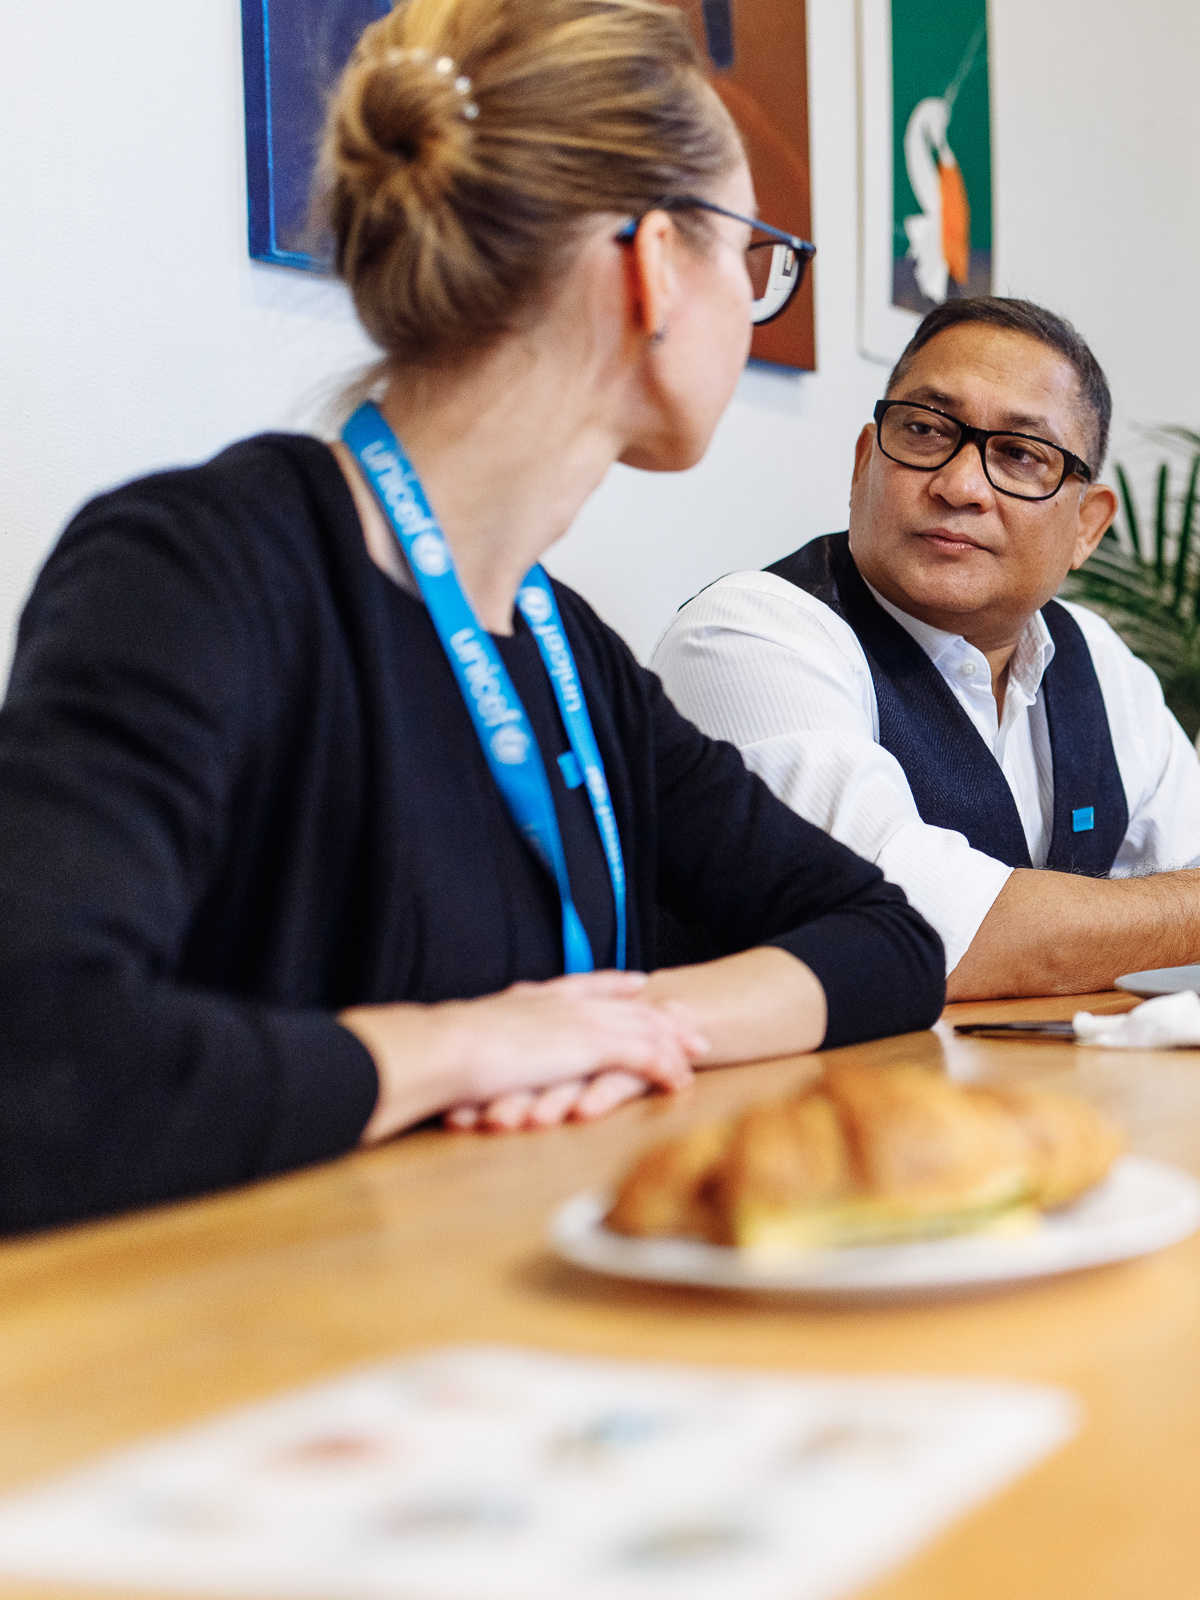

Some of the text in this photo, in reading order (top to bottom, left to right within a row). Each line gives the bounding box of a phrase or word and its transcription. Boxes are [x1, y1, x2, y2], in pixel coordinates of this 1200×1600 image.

[361, 440, 435, 535] unicef
[450, 627, 522, 727] unicef
[532, 623, 581, 712] unicef
